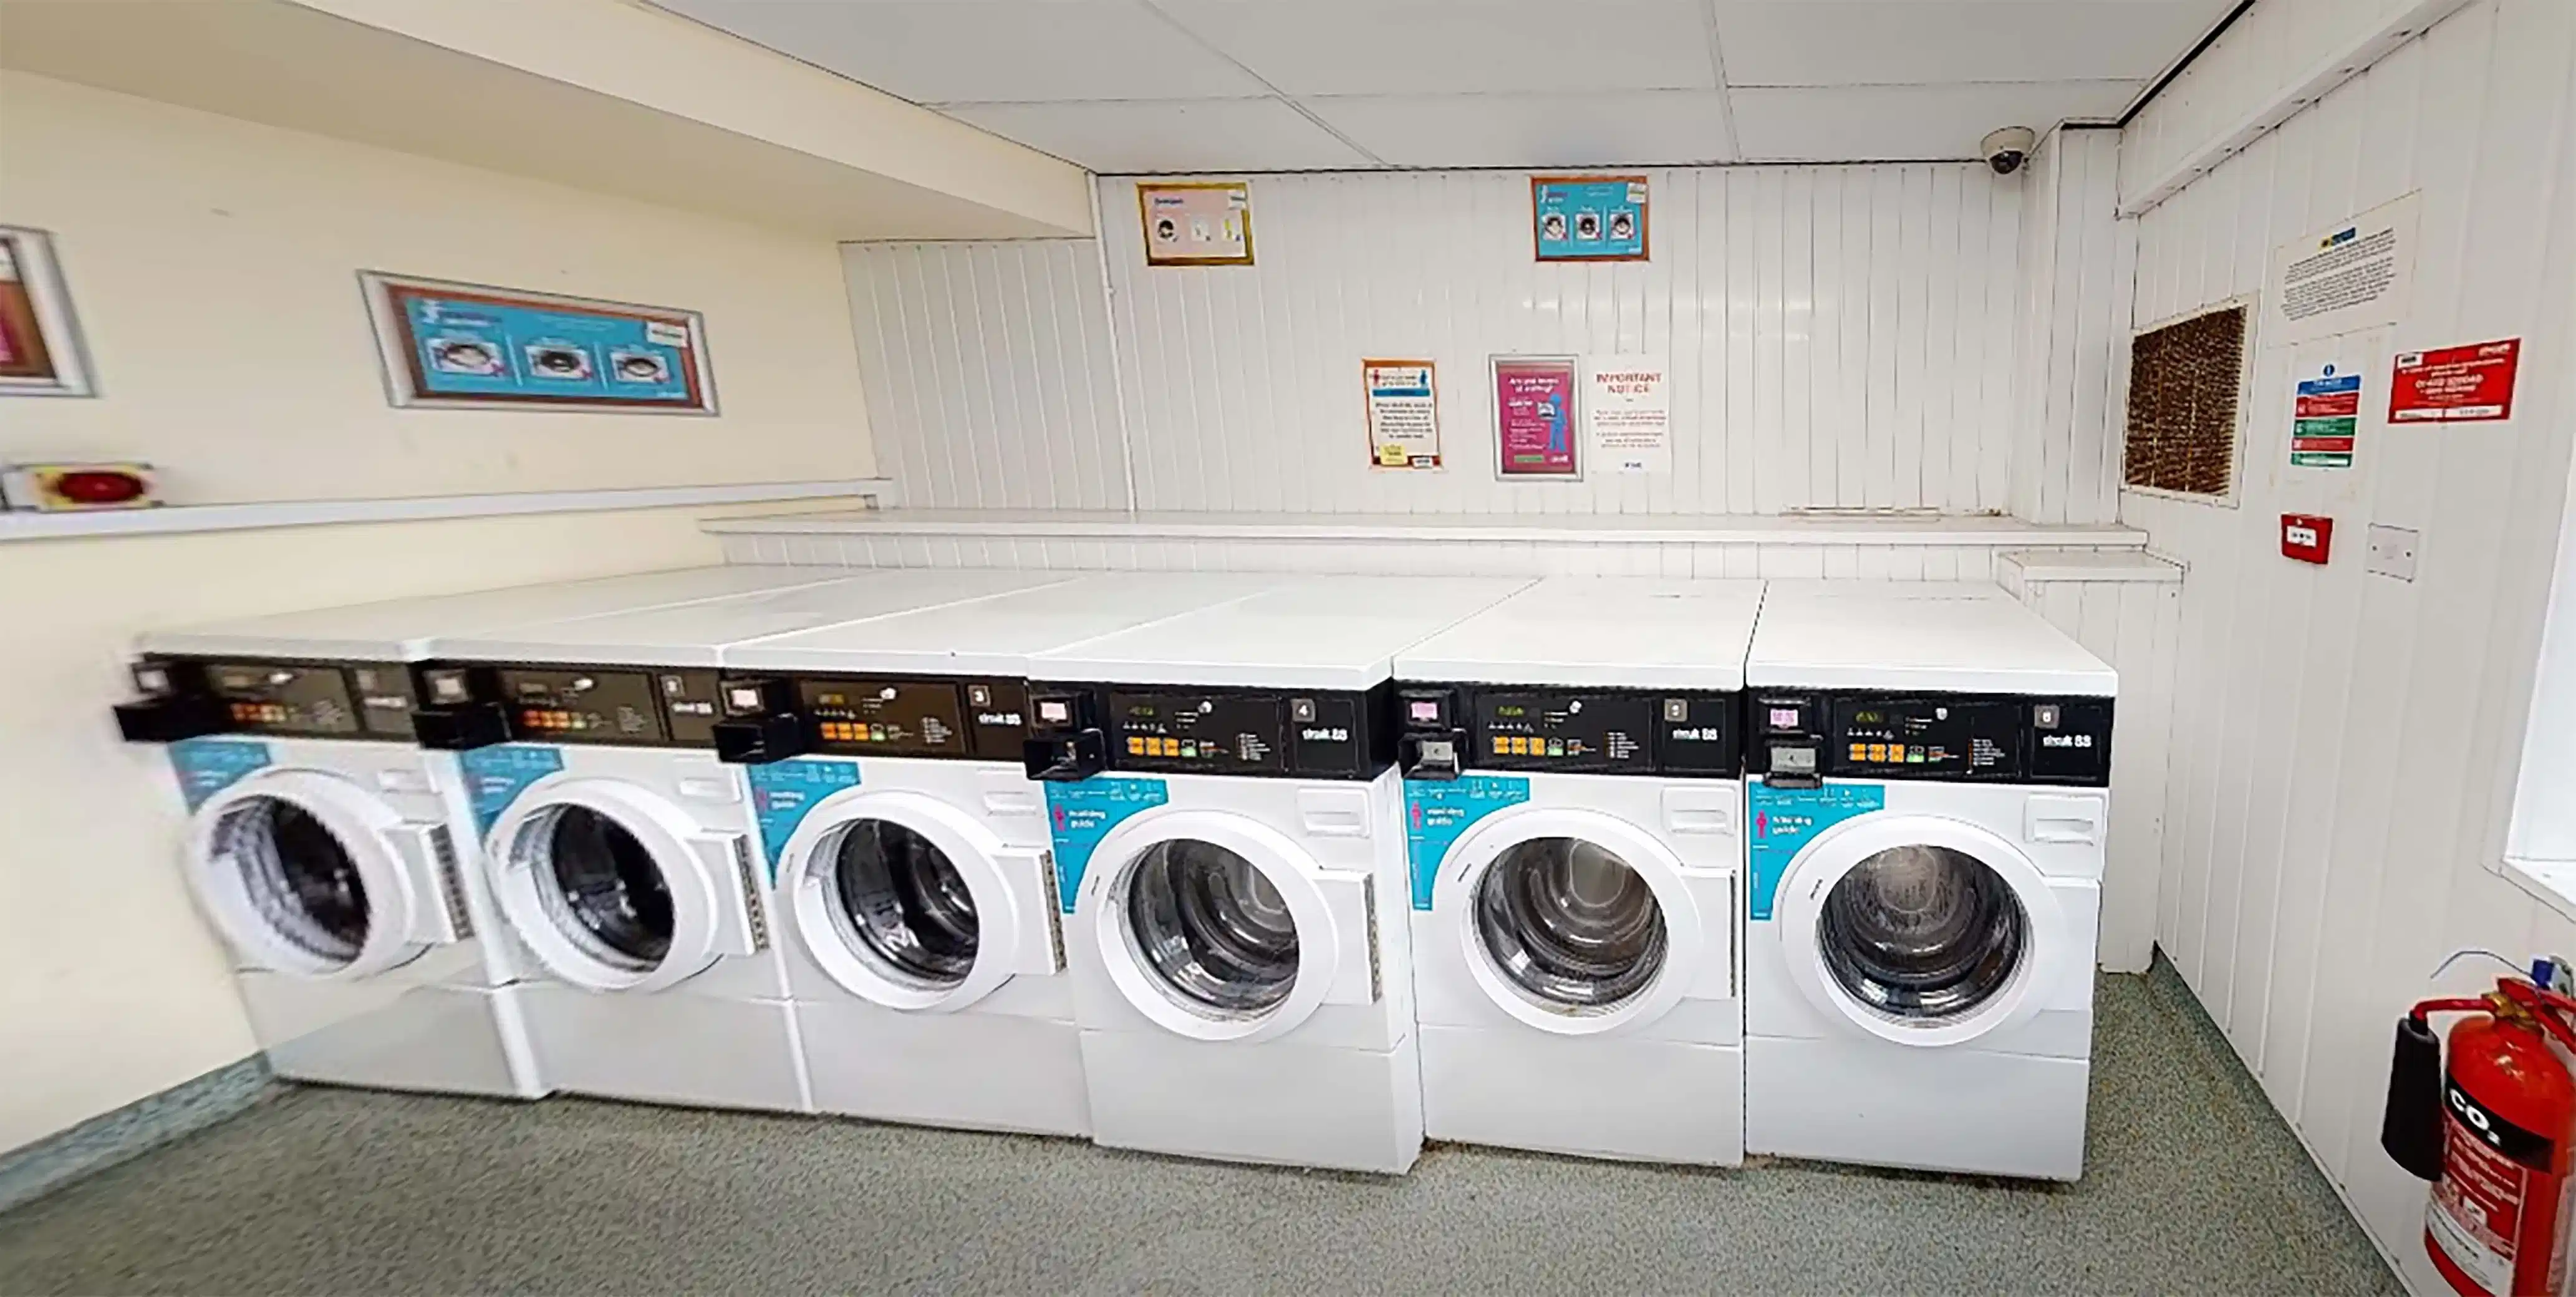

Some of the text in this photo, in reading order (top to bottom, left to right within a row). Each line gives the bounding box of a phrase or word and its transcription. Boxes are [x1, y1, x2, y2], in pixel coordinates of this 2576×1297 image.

[1596, 373, 1662, 383] IMPORTANT
[1607, 383, 1649, 393] NOTICE
[1298, 704, 1308, 716] 4
[2074, 734, 2092, 748] 88
